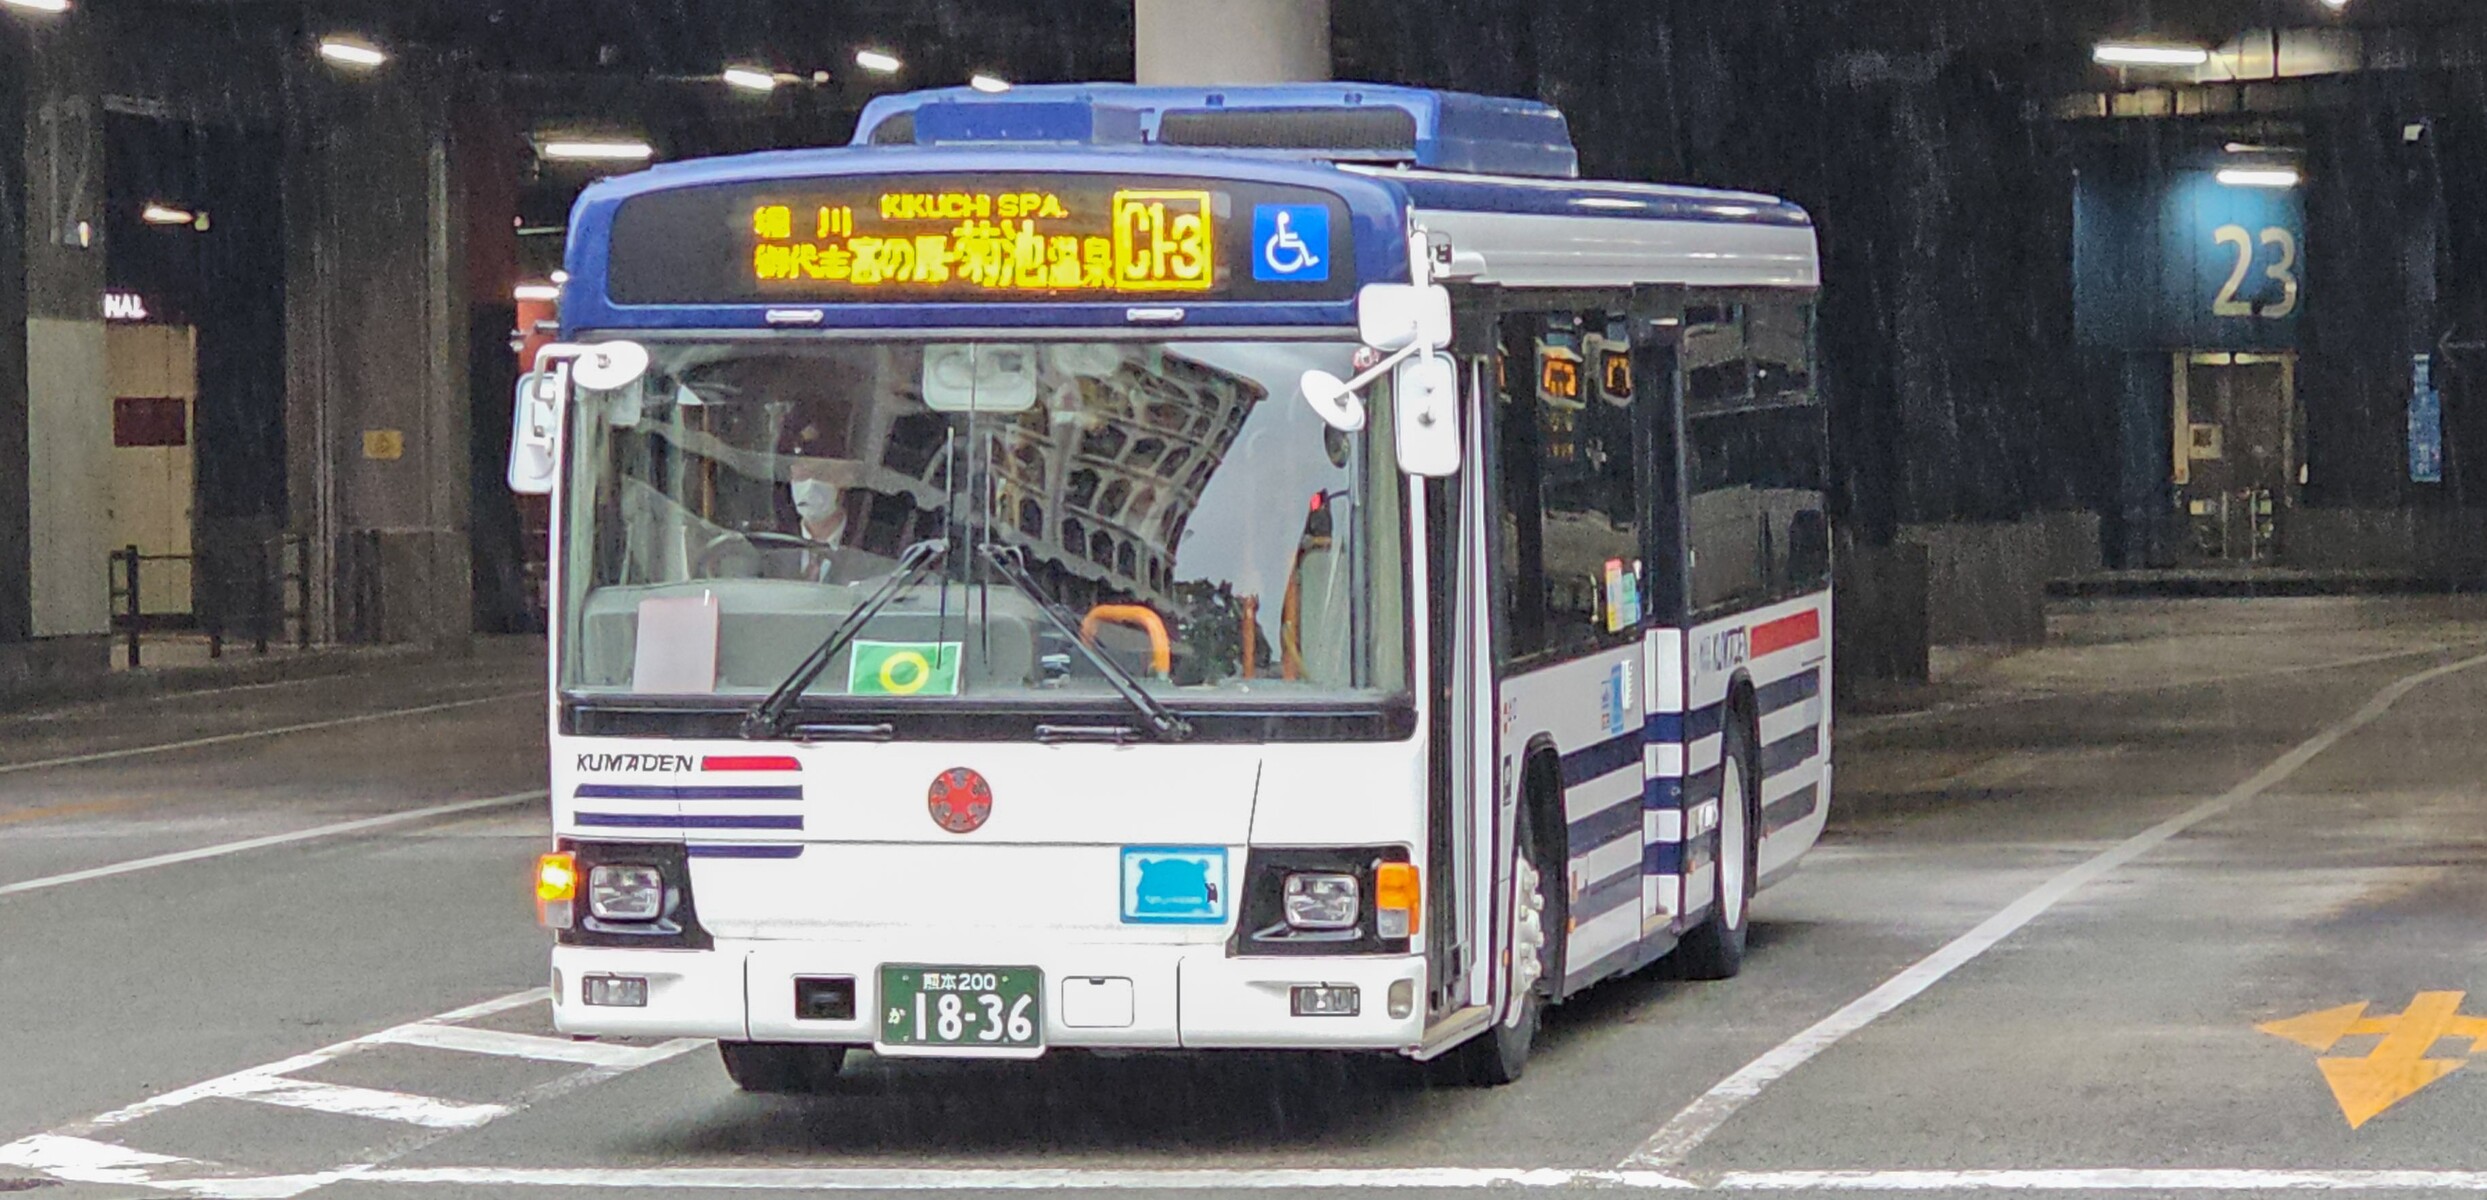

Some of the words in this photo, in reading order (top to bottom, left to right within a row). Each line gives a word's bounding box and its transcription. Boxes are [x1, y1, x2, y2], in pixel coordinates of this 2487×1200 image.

[881, 193, 990, 219] KIKUCHI
[2212, 224, 2297, 318] 23
[577, 754, 693, 772] KUMADEN
[915, 992, 1032, 1041] 18-36
